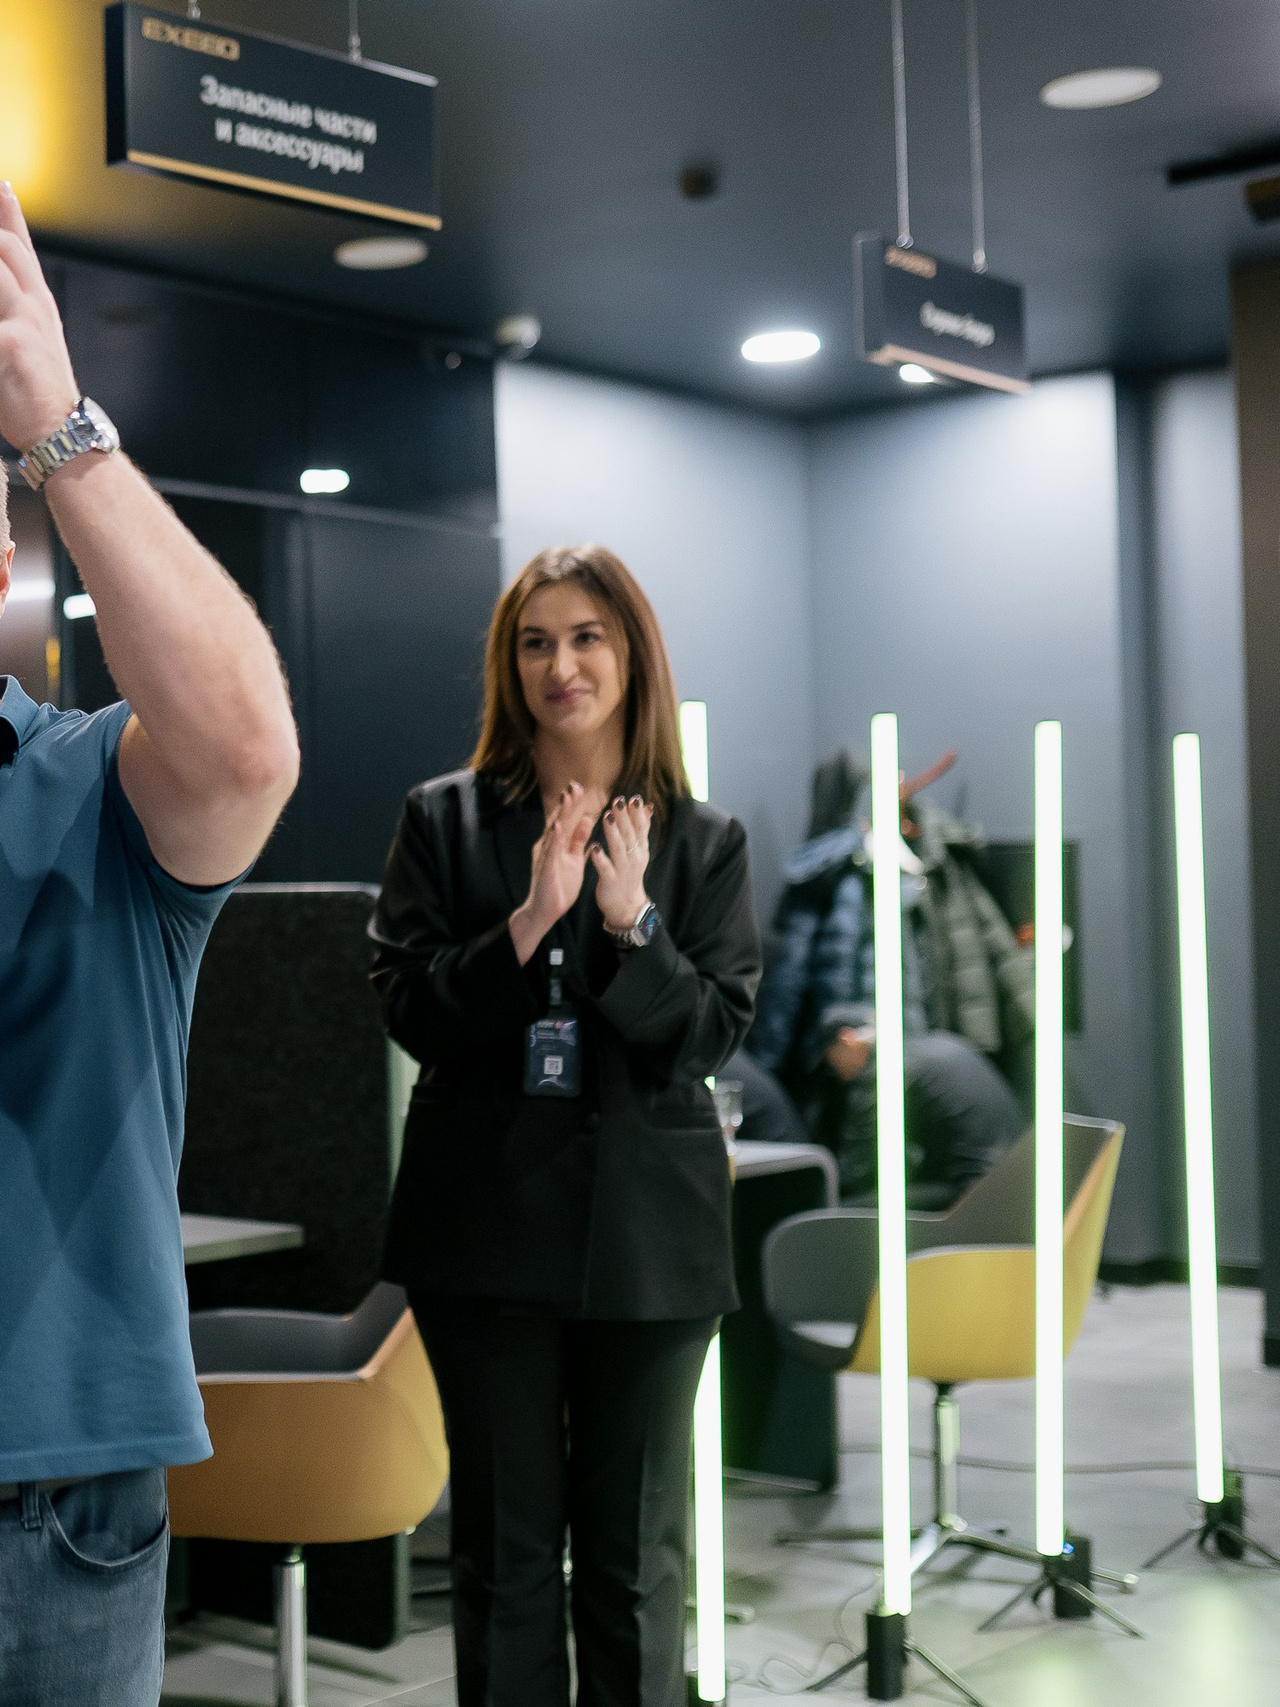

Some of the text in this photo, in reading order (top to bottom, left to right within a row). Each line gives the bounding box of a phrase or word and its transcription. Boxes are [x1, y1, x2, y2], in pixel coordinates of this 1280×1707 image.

[200, 74, 376, 143] Запасные части
[214, 118, 364, 173] и аксессуары
